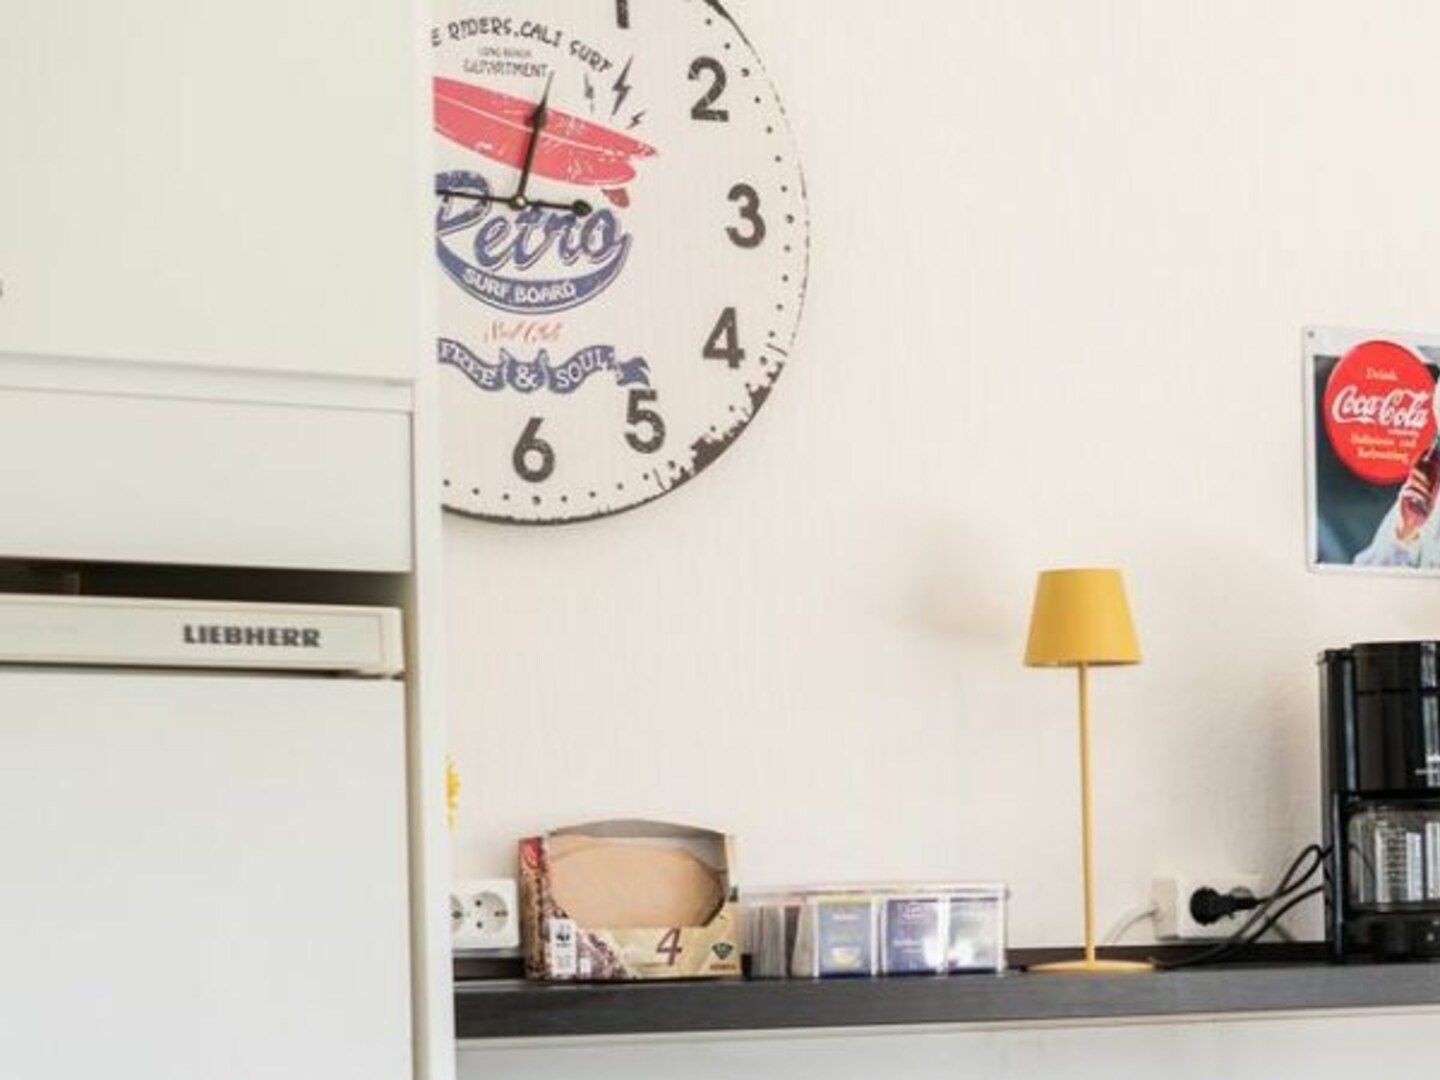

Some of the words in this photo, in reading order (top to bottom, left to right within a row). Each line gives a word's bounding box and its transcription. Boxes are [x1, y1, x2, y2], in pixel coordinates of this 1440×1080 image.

[569, 40, 613, 73] SURF
[688, 56, 730, 122] 2
[726, 183, 766, 249] 3
[462, 267, 513, 300] SURF
[513, 280, 578, 303] BOARD
[702, 307, 745, 369] 4
[515, 365, 539, 388] &
[556, 347, 613, 388] SOUL
[624, 388, 666, 454] 5
[512, 417, 555, 483] 6
[183, 624, 321, 648] LIEBHERR
[656, 926, 683, 967] 4
